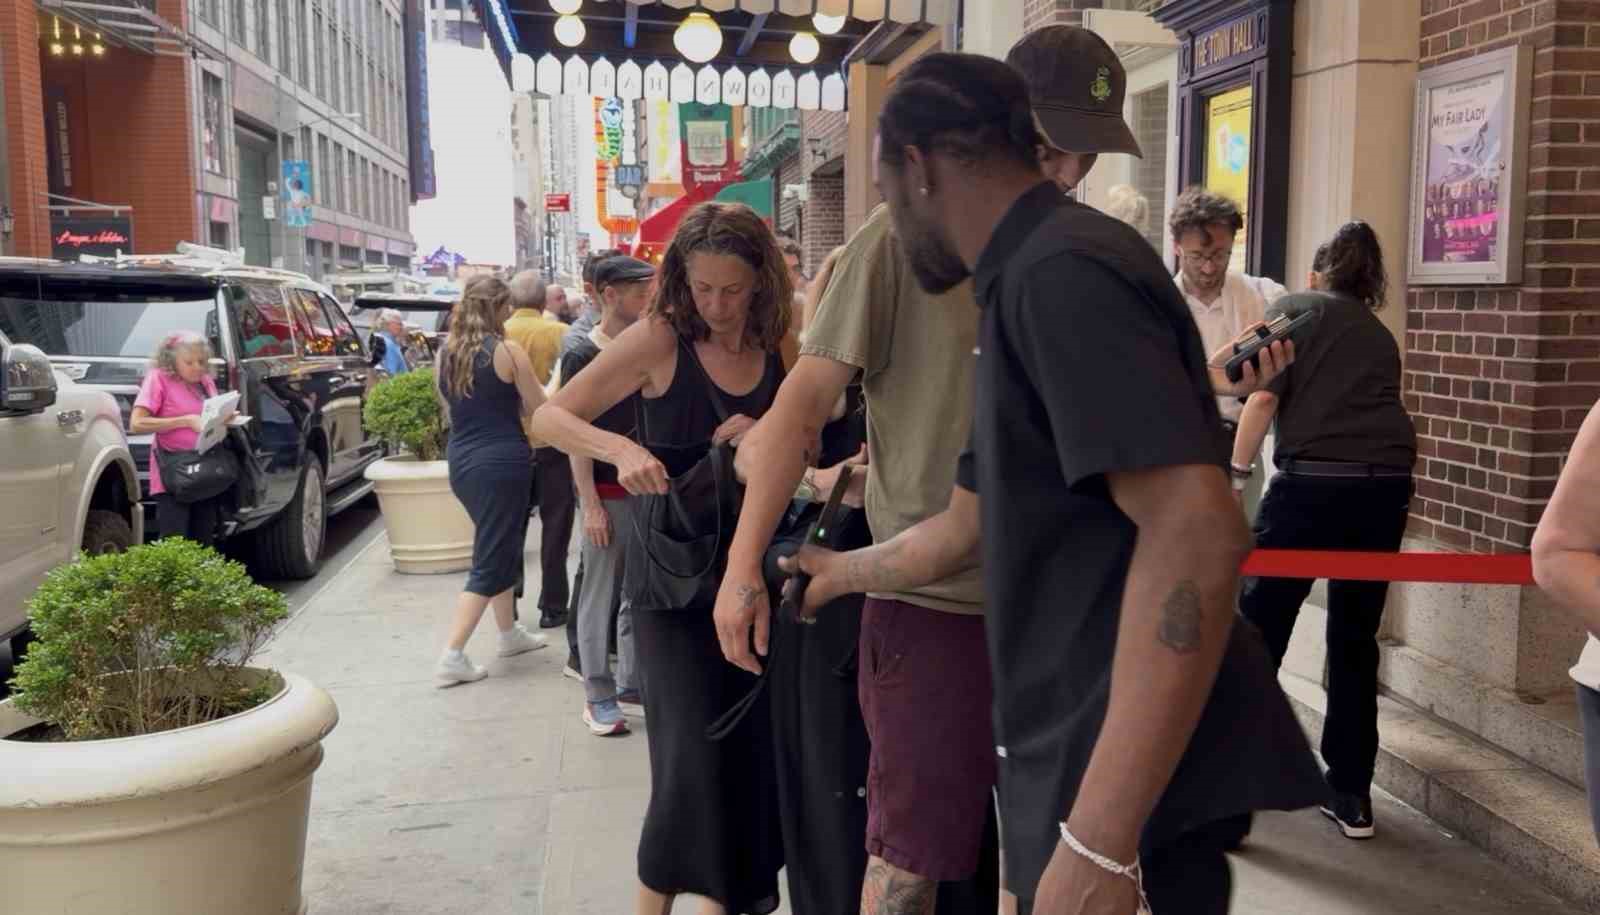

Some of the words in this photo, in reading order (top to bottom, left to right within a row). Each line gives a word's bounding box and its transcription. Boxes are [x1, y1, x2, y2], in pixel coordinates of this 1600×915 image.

[1232, 18, 1254, 56] HALL
[1431, 112, 1446, 129] MY
[1446, 109, 1464, 128] FAIR
[1465, 105, 1487, 122] LADY
